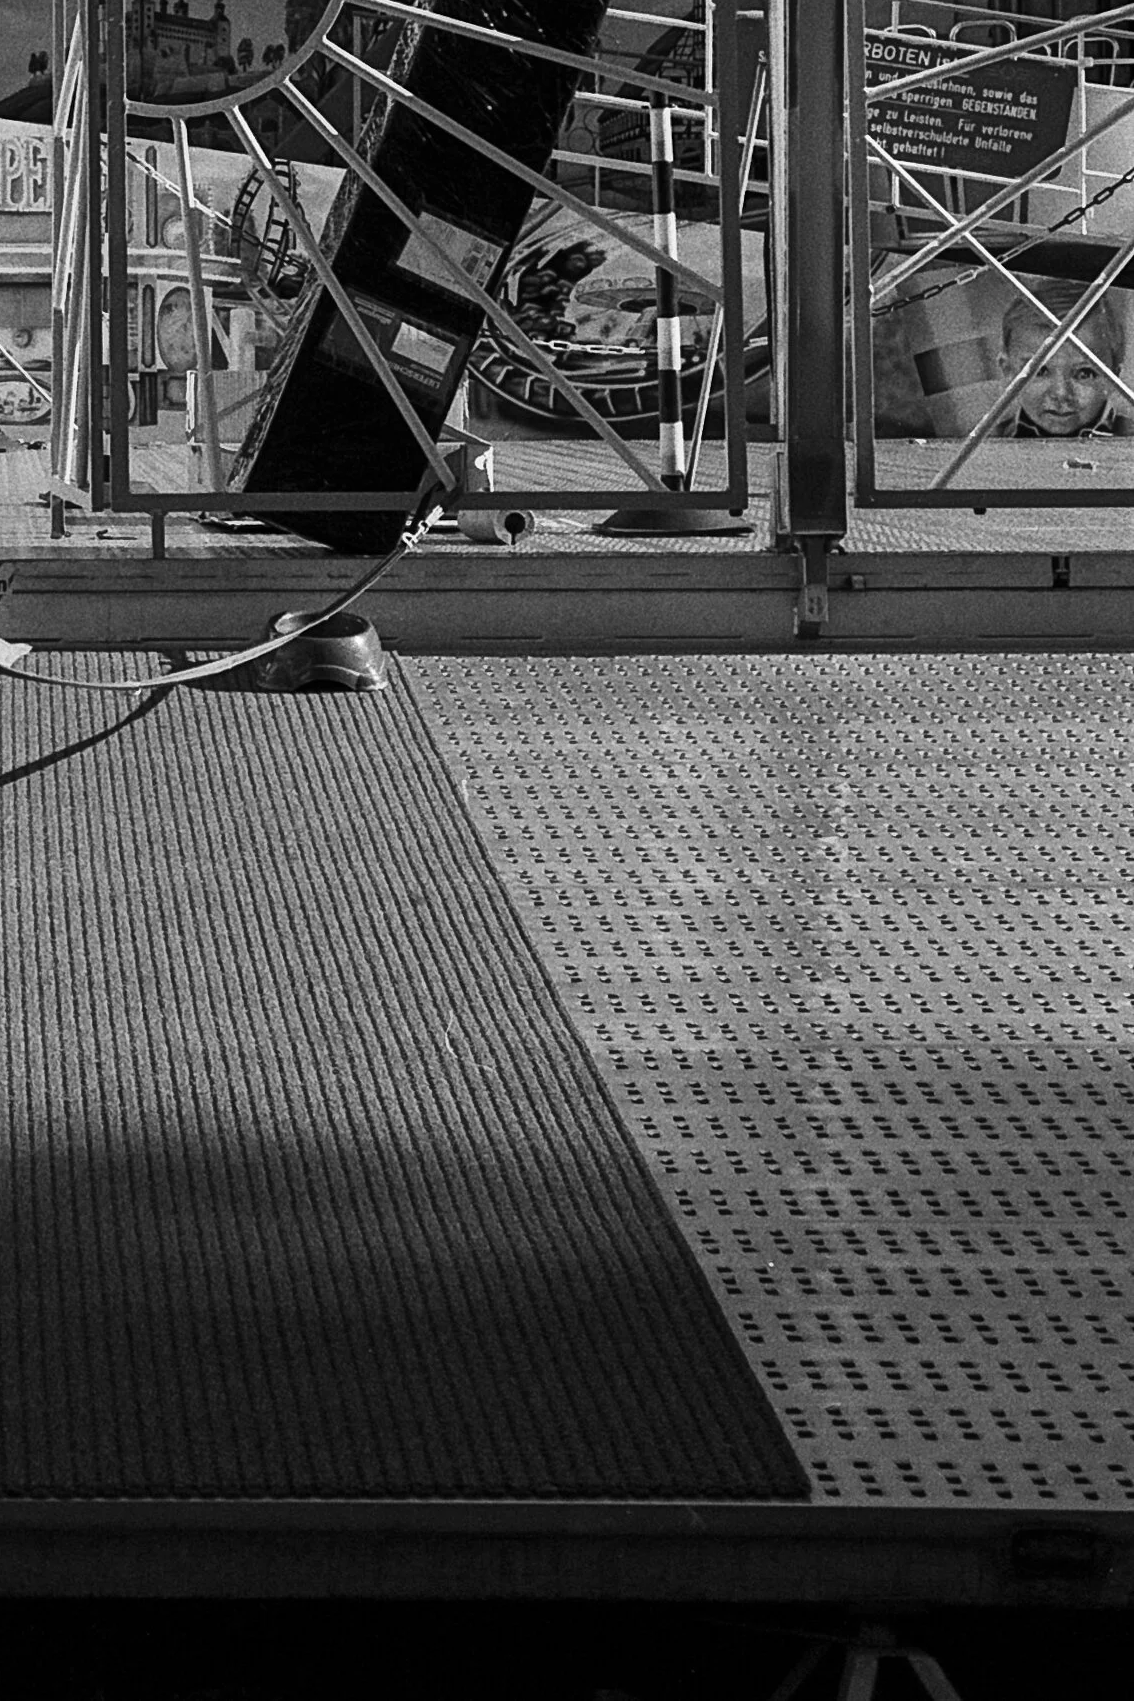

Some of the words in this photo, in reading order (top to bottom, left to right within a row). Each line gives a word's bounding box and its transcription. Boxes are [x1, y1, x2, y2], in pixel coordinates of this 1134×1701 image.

[865, 41, 932, 67] RBOTEN
[901, 91, 954, 110] sperrigen
[982, 86, 1014, 102] sowie
[1019, 90, 1038, 107] das
[869, 121, 971, 148] selbstverschuldete
[974, 135, 1014, 155] Unfälle
[886, 109, 899, 120] zu
[957, 117, 977, 132] Für
[981, 123, 1034, 142] verlorene
